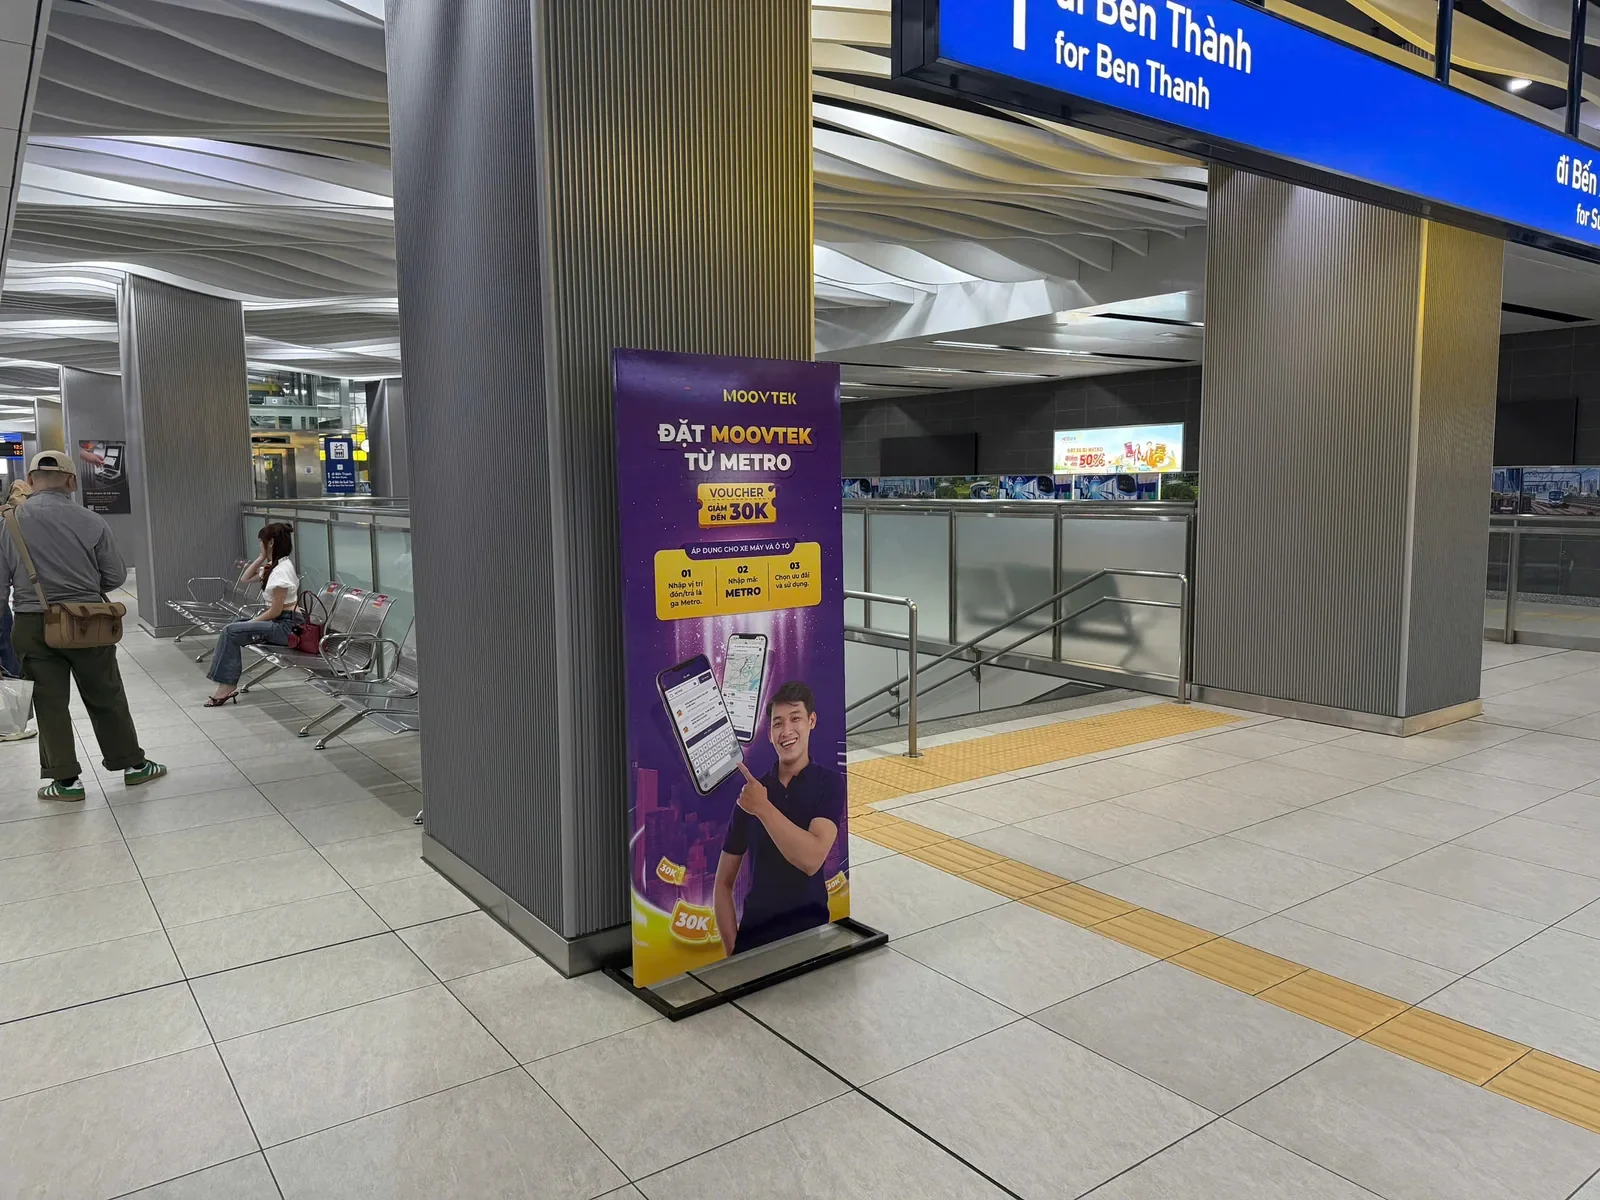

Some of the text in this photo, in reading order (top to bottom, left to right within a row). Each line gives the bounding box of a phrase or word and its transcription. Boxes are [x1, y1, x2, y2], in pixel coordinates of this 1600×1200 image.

[1166, 0, 1251, 74] Thành
[1055, 30, 1210, 110] for Ben Thanh
[1556, 154, 1597, 196] đi Bến
[1576, 203, 1590, 226] for
[723, 389, 797, 405] MOOVTEK
[657, 418, 812, 448] ĐẶT MOOVTEK
[684, 448, 792, 471] TỪ METRO
[1079, 453, 1105, 466] 50%
[710, 487, 764, 498] VOUCHER
[707, 503, 727, 513] GIẢM
[729, 502, 768, 520] 30K
[710, 512, 727, 522] ĐẾN
[690, 546, 701, 555] ÁP
[702, 546, 722, 555] DỤNG
[681, 569, 692, 578] 01
[668, 582, 686, 590] Nhập
[726, 587, 761, 598] METRO
[660, 864, 677, 877] 30K
[826, 879, 840, 891] 30K
[675, 912, 710, 931] 30K
